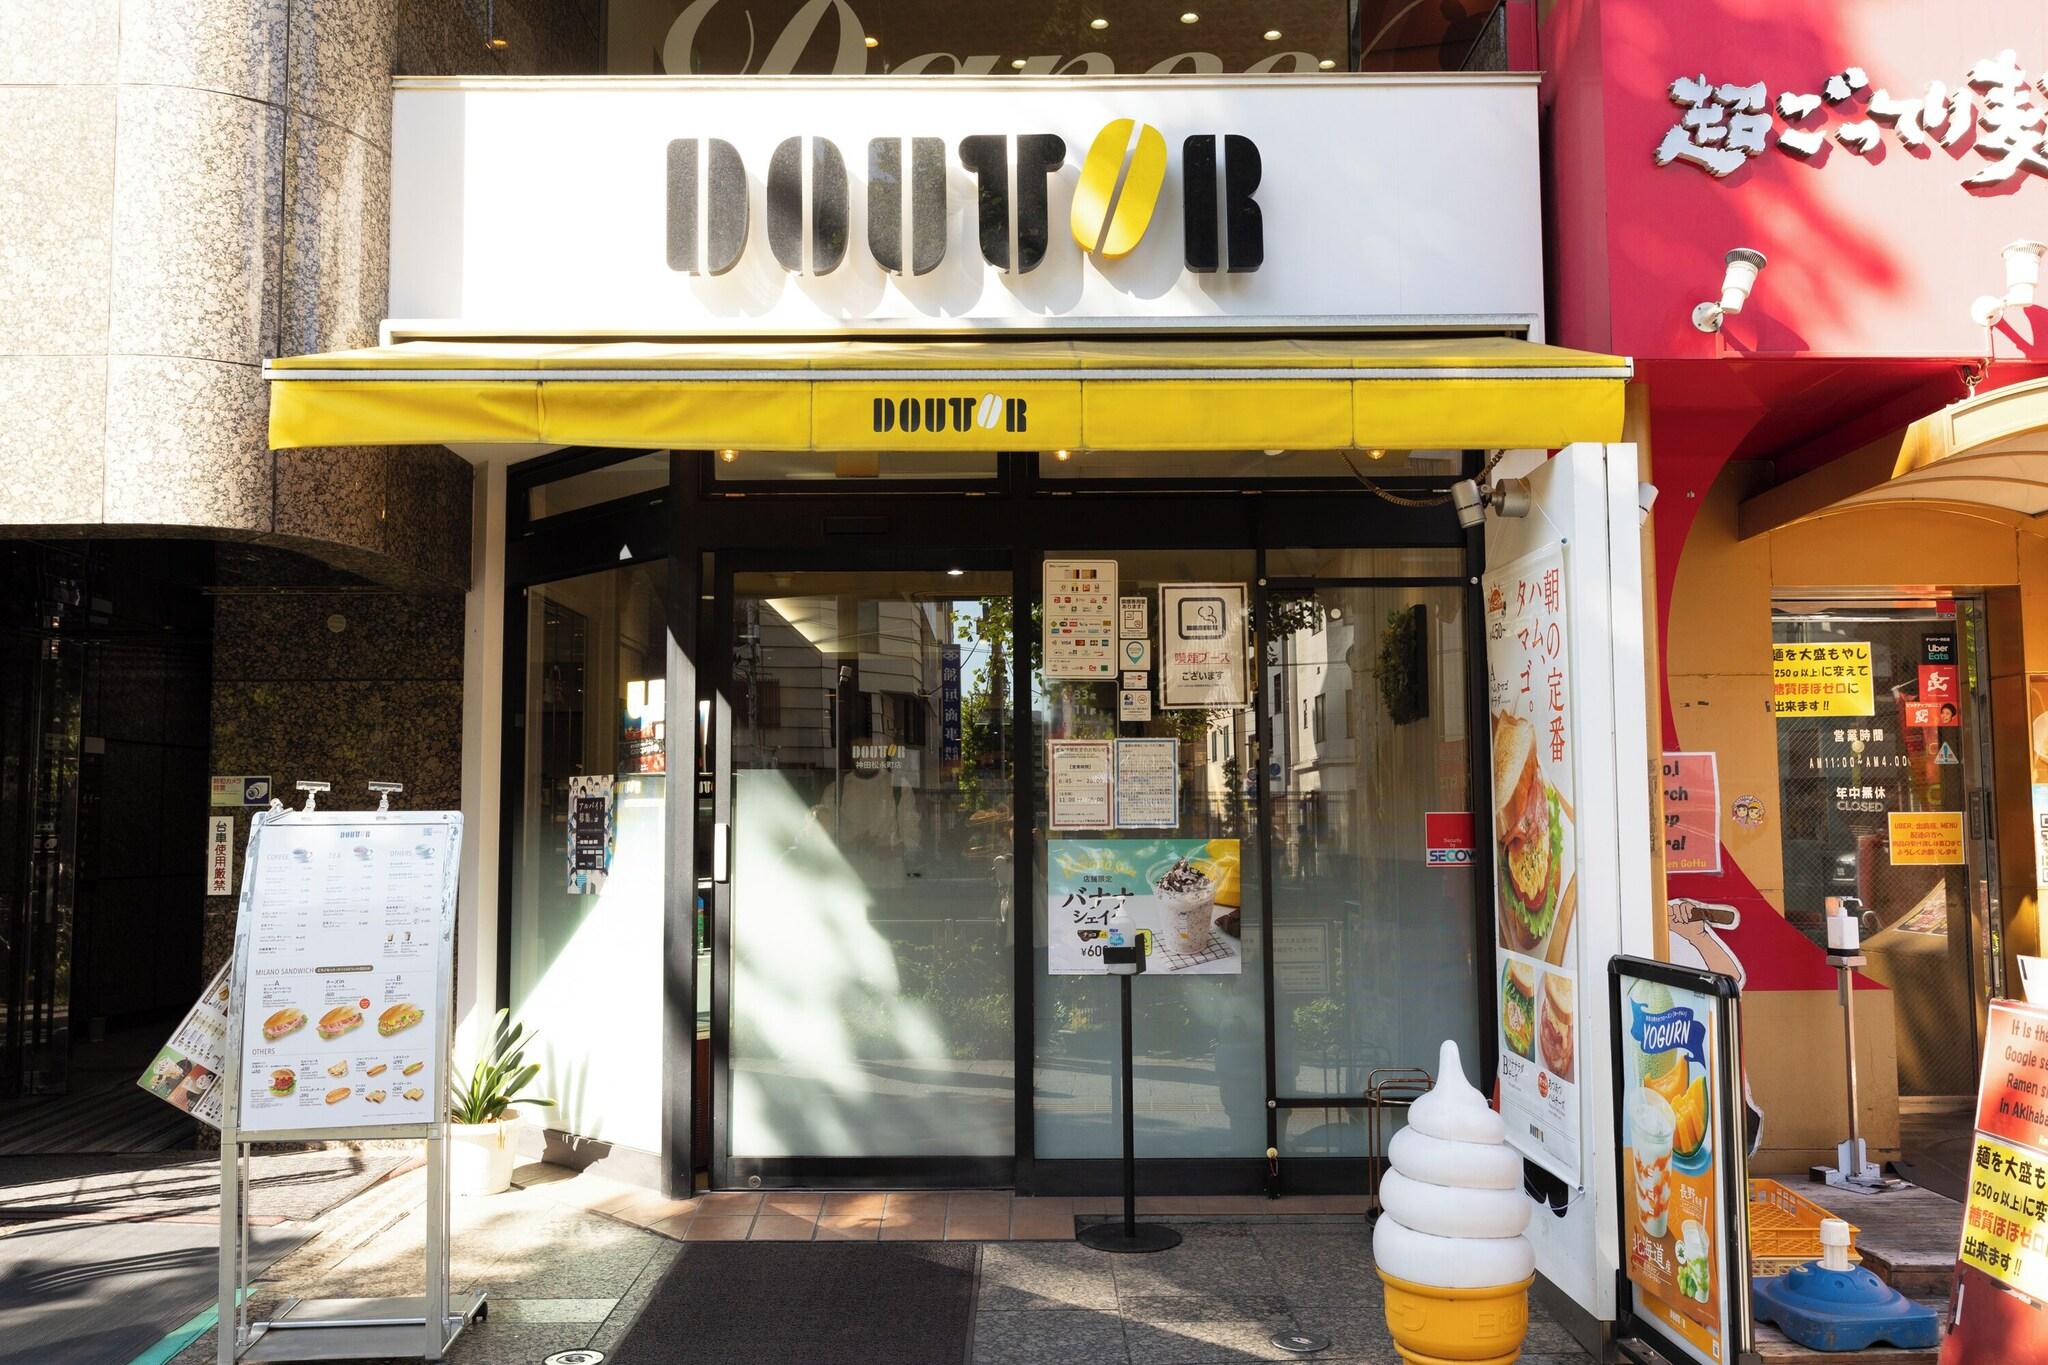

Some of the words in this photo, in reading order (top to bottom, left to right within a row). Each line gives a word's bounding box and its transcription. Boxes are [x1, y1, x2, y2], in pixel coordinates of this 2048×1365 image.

[666, 118, 1264, 276] DOUTOR
[873, 393, 1027, 433] DOUTOR
[1927, 644, 1949, 653] Uber
[1928, 652, 1950, 661] Eats
[1174, 651, 1233, 664] 喫煙ブース
[1543, 567, 1566, 763] 朝の定番
[1181, 670, 1225, 681] ございます
[1833, 729, 1884, 743] 営業時間
[852, 743, 906, 759] DOUTOR
[1836, 786, 1886, 800] 年中無休
[1836, 801, 1885, 812] CLOSED
[213, 820, 228, 892] 台車使用厳禁
[1061, 886, 1135, 909] バナナ
[1081, 944, 1110, 957] ¥60
[255, 968, 280, 976] MILANO
[280, 967, 315, 975] SANDWICH
[1643, 1020, 1691, 1050] YOGURN
[2012, 1018, 2021, 1036] It
[2023, 1021, 2032, 1039] is
[251, 1048, 276, 1056] OTHERS
[2005, 1045, 2038, 1068] Google
[2007, 1073, 2038, 1096] Ramen
[1999, 1098, 2009, 1115] in
